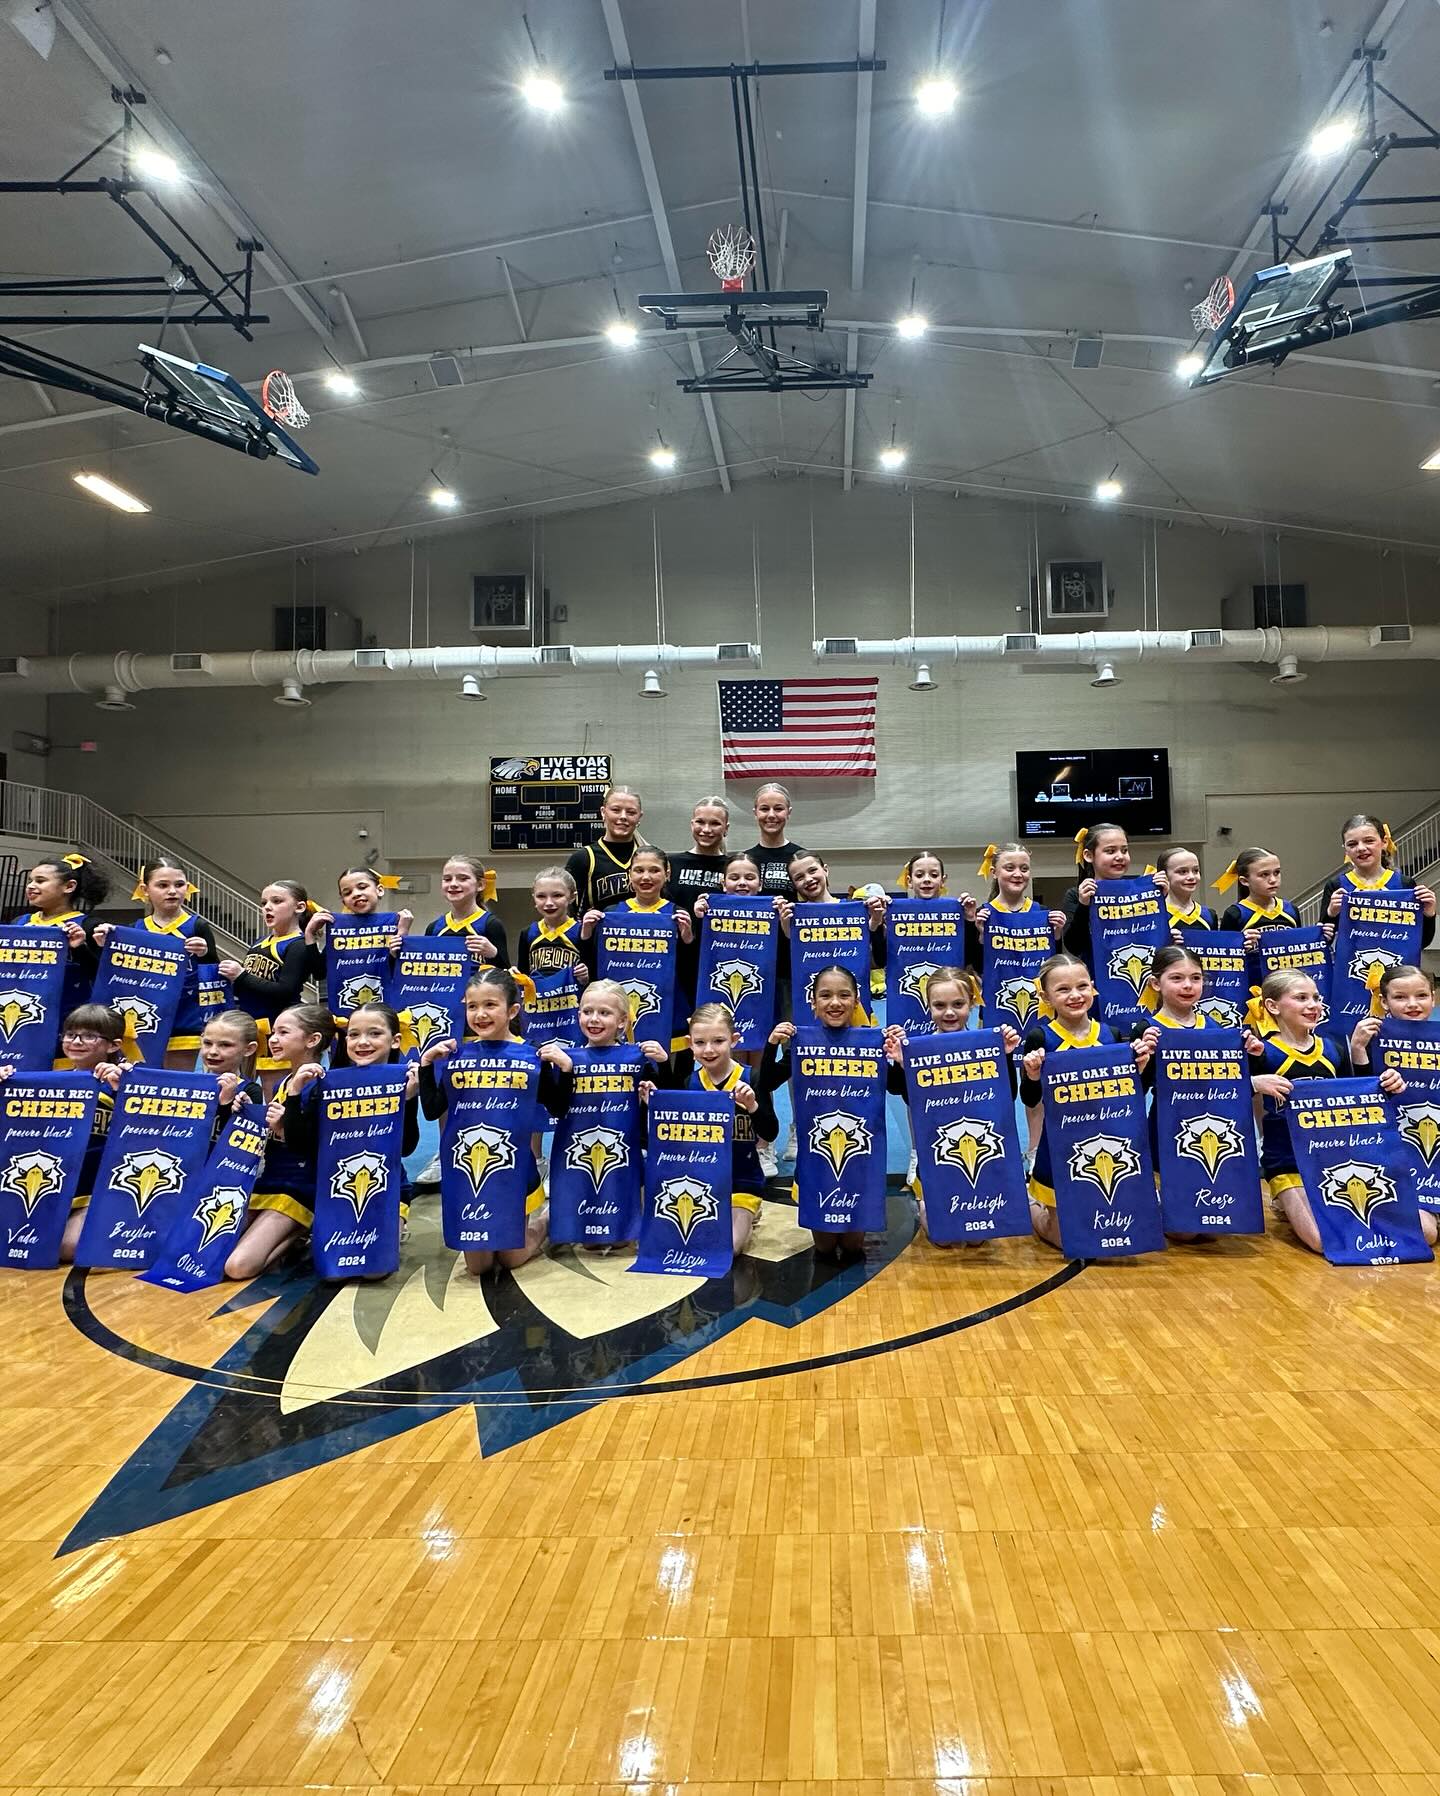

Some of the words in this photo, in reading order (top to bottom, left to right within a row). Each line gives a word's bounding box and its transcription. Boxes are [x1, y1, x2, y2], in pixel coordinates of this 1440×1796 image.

[540, 758, 572, 768] LIVE
[576, 757, 608, 768] OAK
[540, 768, 608, 780] EAGLES
[496, 786, 517, 794] HOME
[680, 869, 702, 880] LIVE
[1094, 896, 1116, 904] LIVE
[1118, 894, 1139, 903] OAK
[1141, 890, 1160, 898] REC
[1348, 896, 1372, 906] LIVE
[1374, 898, 1398, 908] OAK
[1400, 901, 1420, 911] REC
[707, 909, 731, 917] LIVE
[733, 910, 754, 918] OAK
[756, 911, 776, 919] REC
[892, 913, 914, 921] LIVE
[918, 912, 939, 920] OAK
[941, 912, 961, 920] REC
[1098, 900, 1160, 920] CHEER
[1350, 906, 1416, 926] CHEER
[710, 918, 771, 936] CHEER
[795, 918, 820, 926] LIVE
[822, 918, 844, 926] OAK
[846, 916, 866, 924] REC
[1132, 920, 1158, 934] black
[330, 928, 356, 936] LIVE
[359, 926, 380, 934] OAK
[602, 928, 627, 936] LIVE
[630, 928, 650, 937] OAK
[653, 930, 673, 938] REC
[800, 926, 863, 942] CHEER
[894, 922, 957, 937] CHEER
[988, 925, 1010, 934] LIVE
[1011, 928, 1031, 936] OAK
[1034, 926, 1052, 935] REC
[1381, 929, 1409, 940] black
[14, 940, 37, 949] OAK
[40, 940, 63, 950] REC
[605, 938, 668, 954] CHEER
[740, 940, 765, 950] black
[928, 942, 952, 952] black
[991, 936, 1050, 952] CHEER
[1262, 947, 1286, 956] LIVE
[1288, 944, 1308, 954] OAK
[1310, 940, 1327, 950] REC
[110, 941, 136, 953] LIVE
[138, 946, 162, 958] OAK
[164, 950, 186, 962] REC
[400, 952, 423, 960] LIVE
[425, 952, 446, 960] OAK
[448, 953, 468, 961] REC
[832, 948, 859, 958] black
[1207, 948, 1227, 956] OAK
[110, 952, 178, 976] CHEER
[636, 959, 662, 969] black
[1266, 951, 1326, 971] CHEER
[18, 969, 49, 980] black
[400, 962, 463, 978] CHEER
[140, 976, 169, 990] black
[1216, 976, 1241, 988] black
[1379, 1038, 1412, 1050] LIVE
[796, 1046, 826, 1056] LIVE
[830, 1046, 856, 1057] OAK
[860, 1048, 883, 1058] REC
[910, 1056, 942, 1068] LIVE
[945, 1052, 972, 1063] OAK
[976, 1046, 1000, 1058] REC
[1162, 1050, 1191, 1060] LIVE
[1194, 1050, 1218, 1060] OAK
[1222, 1050, 1244, 1060] REC
[448, 1060, 476, 1070] LIVE
[480, 1058, 508, 1068] OAK
[590, 1064, 616, 1074] OAK
[620, 1064, 641, 1073] REC
[800, 1058, 878, 1078] CHEER
[1166, 1062, 1243, 1080] CHEER
[451, 1070, 528, 1090] CHEER
[916, 1060, 1000, 1088] CHEER
[1048, 1072, 1079, 1085] LIVE
[1082, 1068, 1110, 1080] OAK
[1113, 1064, 1136, 1075] REC
[4, 1088, 35, 1098] LIVE
[38, 1089, 66, 1099] OAK
[68, 1089, 94, 1100] REC
[124, 1084, 158, 1096] LIVE
[160, 1086, 190, 1099] OAK
[190, 1090, 216, 1101] REC
[322, 1088, 353, 1100] LIVE
[356, 1084, 383, 1096] OAK
[840, 1084, 871, 1098] black
[962, 1088, 996, 1105] black
[1054, 1077, 1136, 1104] CHEER
[1207, 1087, 1238, 1100] black
[124, 1096, 208, 1120] CHEER
[326, 1096, 400, 1120] CHEER
[485, 1097, 520, 1110] black
[600, 1100, 630, 1113] black
[1290, 1098, 1324, 1110] LIVE
[1326, 1096, 1357, 1108] OAK
[1360, 1094, 1386, 1106] REC
[5, 1100, 86, 1119] CHEER
[654, 1110, 680, 1121] LIVE
[682, 1112, 706, 1122] OAK
[708, 1112, 730, 1122] REC
[1100, 1105, 1134, 1120] black
[1298, 1106, 1387, 1129] CHEER
[43, 1126, 74, 1138] black
[162, 1124, 194, 1138] black
[656, 1123, 725, 1144] CHEER
[1348, 1133, 1385, 1148] black
[688, 1150, 718, 1164] black
[818, 1188, 860, 1209] Violet
[950, 1194, 1008, 1214] Breleigh
[1195, 1188, 1236, 1210] Reese
[824, 1214, 852, 1223] 2024
[1093, 1210, 1135, 1232] Kelby
[1202, 1215, 1232, 1225] 2024
[109, 1221, 157, 1244] Baylor
[584, 1225, 610, 1235] 2024
[965, 1220, 995, 1232] 2024
[324, 1228, 379, 1252] Haileigh
[460, 1232, 489, 1242] 2024
[1101, 1236, 1131, 1248] 2024
[1355, 1234, 1398, 1252] Callie
[8, 1248, 29, 1259] 2024
[112, 1248, 145, 1259] 2024
[176, 1253, 207, 1278] Olivia
[338, 1255, 366, 1267] 2024
